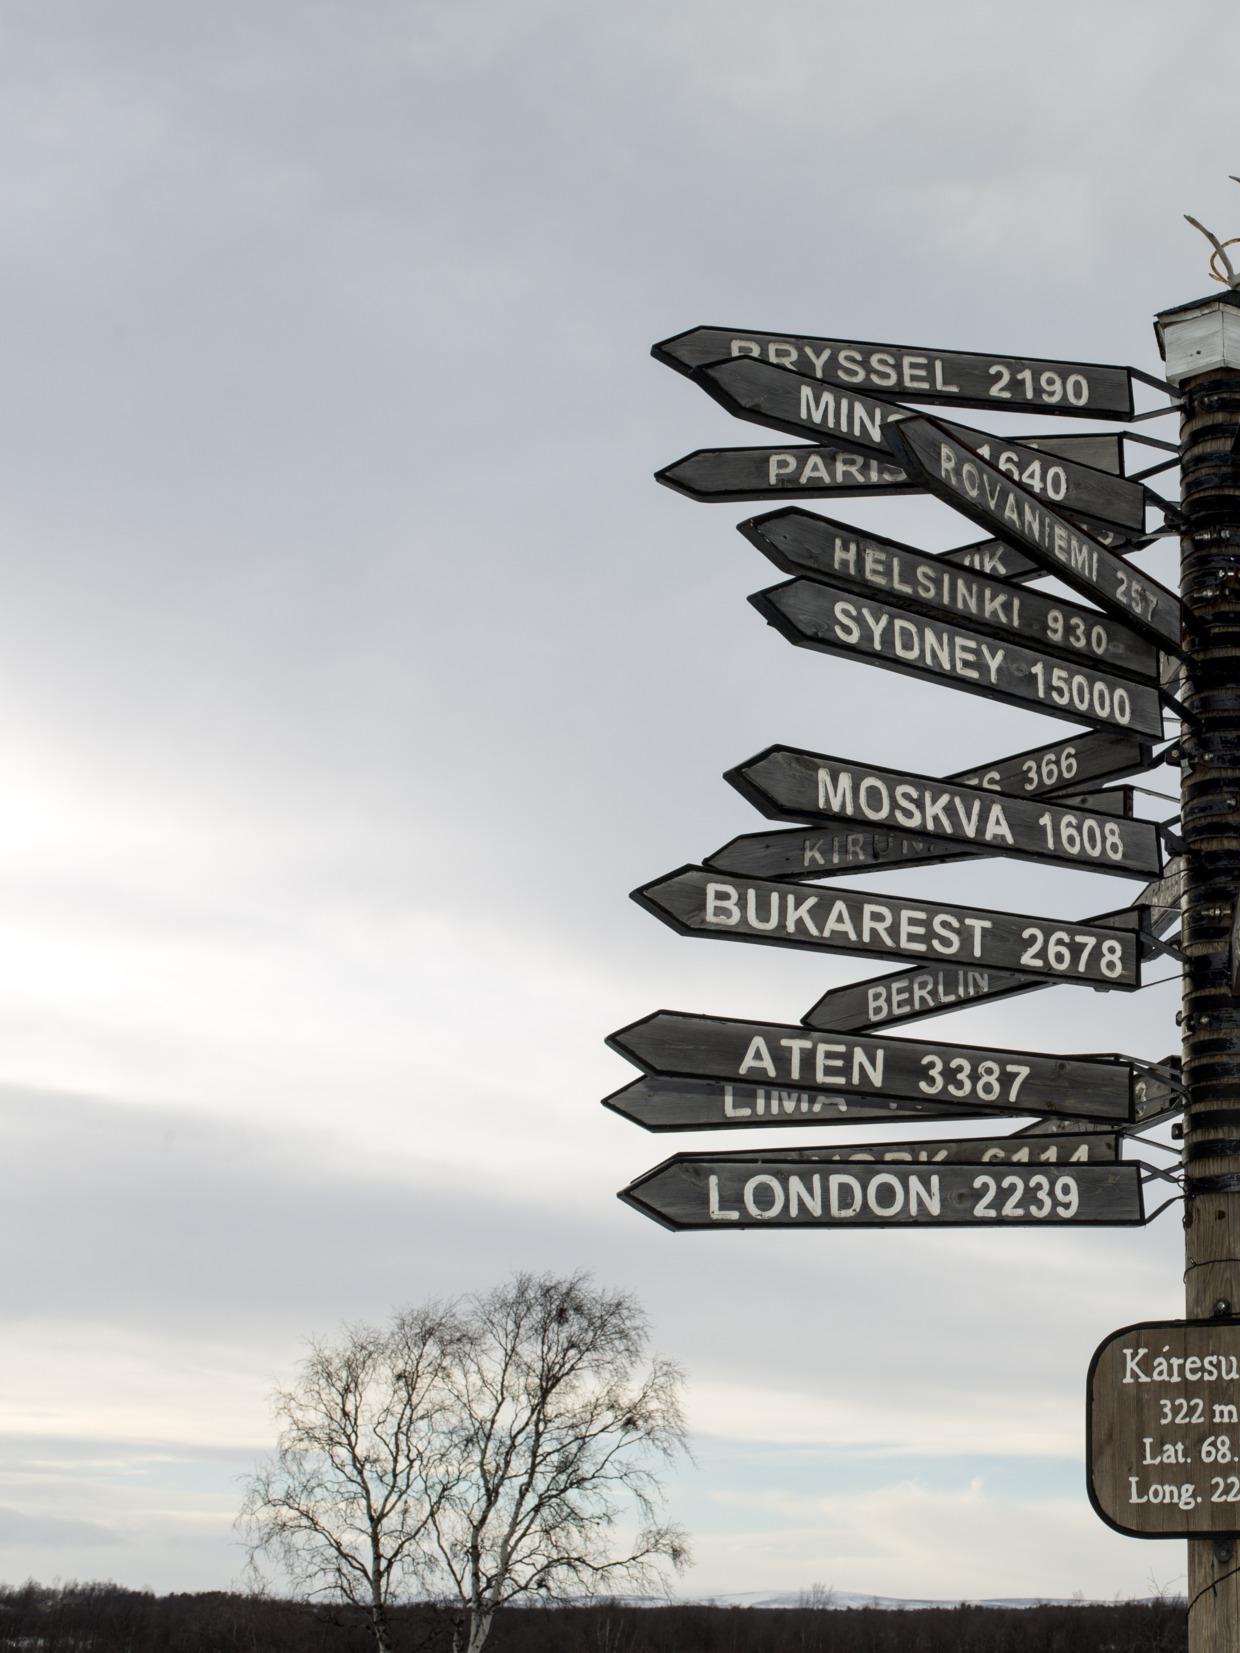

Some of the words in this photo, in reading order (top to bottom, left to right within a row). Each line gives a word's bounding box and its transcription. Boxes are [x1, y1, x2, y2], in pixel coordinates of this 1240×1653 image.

[800, 384, 906, 443] MIN
[989, 365, 1089, 407] 2190
[940, 443, 1098, 582] ROVANIEMI
[833, 536, 1020, 629] HELSINKI
[1047, 609, 1109, 656] 930
[833, 601, 1006, 684] SYDNEY
[1030, 661, 1131, 726] 15000
[1022, 747, 1077, 791] 366
[817, 767, 1014, 845] MOSKVA
[1038, 813, 1124, 863] 1608
[706, 883, 992, 958] BUKAREST
[1021, 928, 1123, 979] 2678
[868, 970, 989, 1022] BERLIN
[738, 1036, 884, 1088] ATEN
[919, 1054, 1031, 1102] 3387
[708, 1172, 941, 1221] LONDON
[972, 1175, 1080, 1218] 2239
[1159, 1398, 1205, 1425] 322
[1142, 1437, 1191, 1465] Lat.
[1128, 1476, 1202, 1510] Long.
